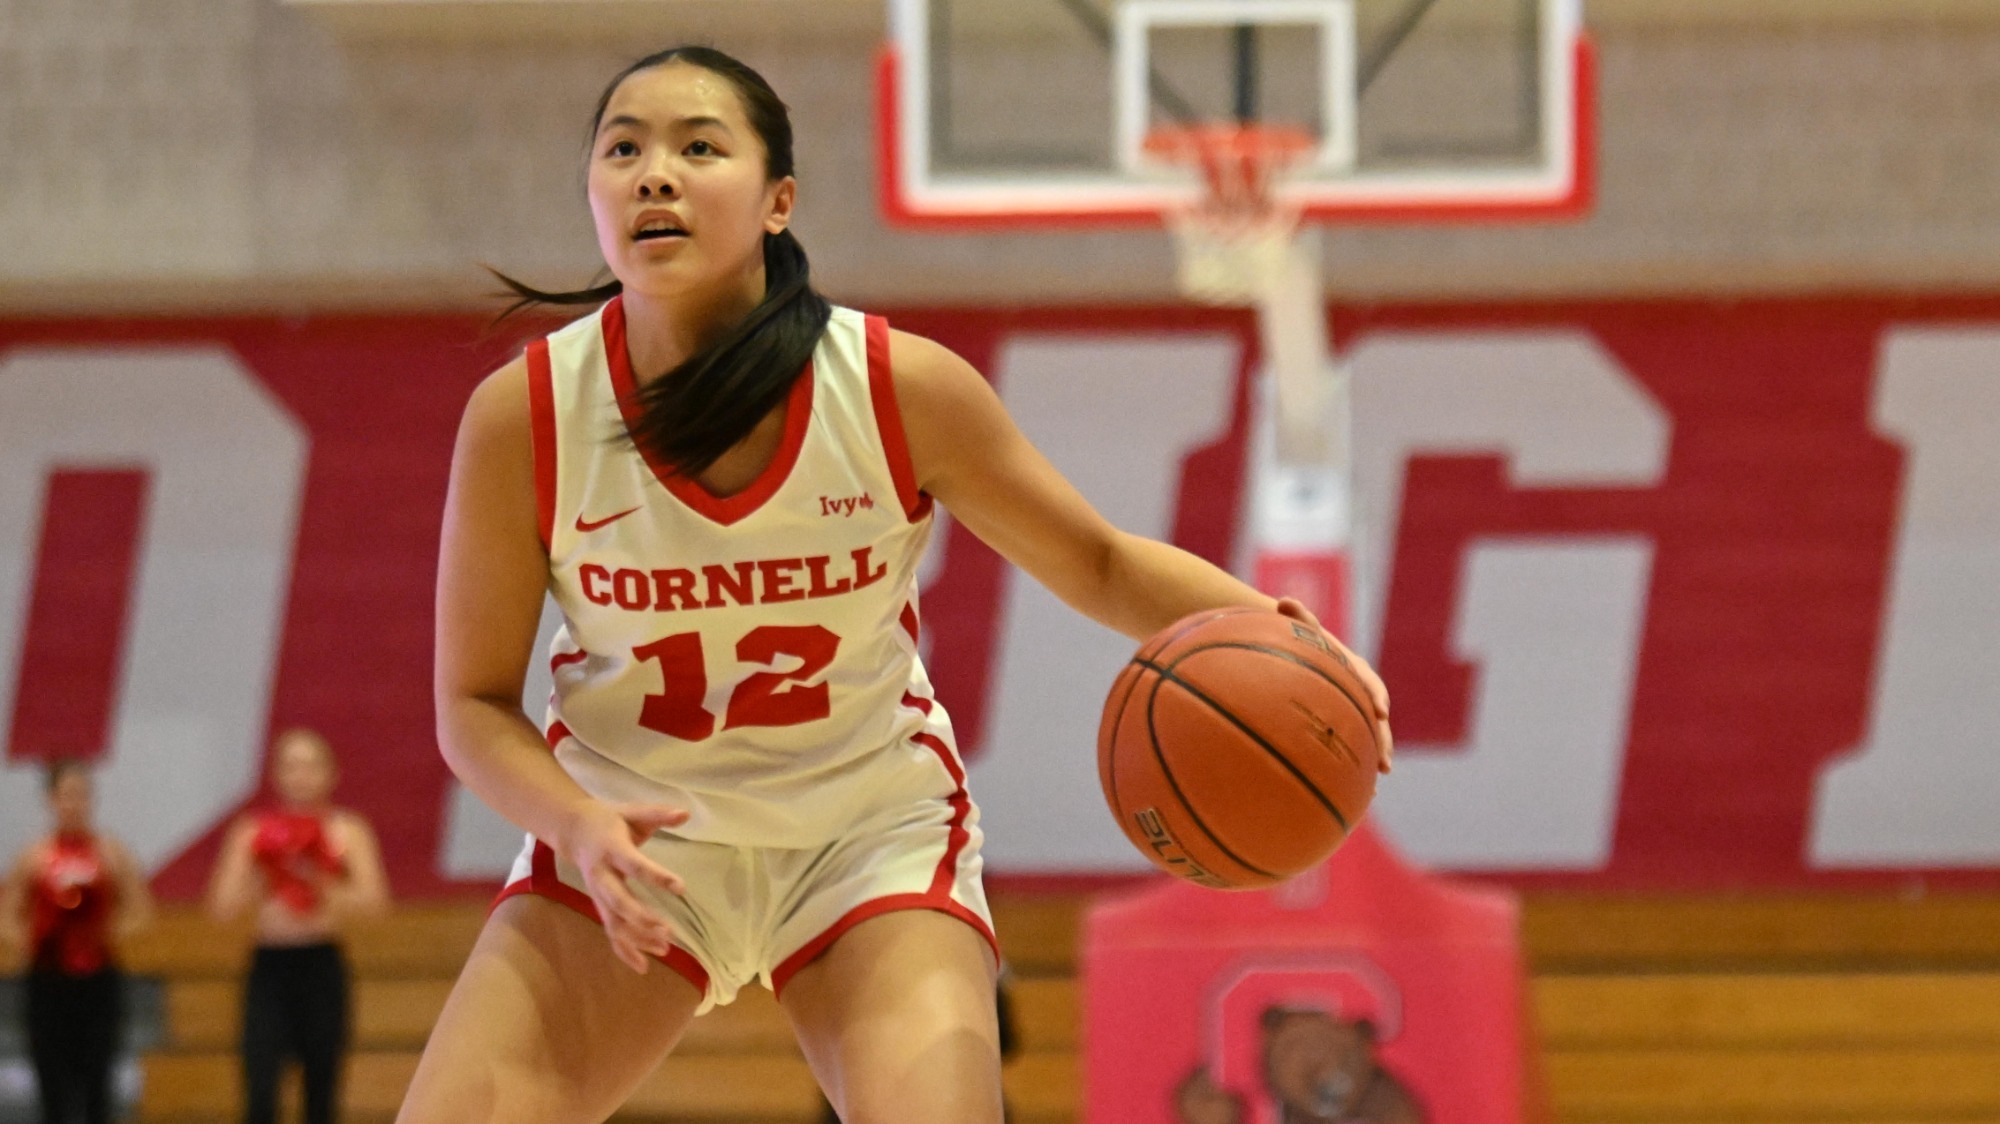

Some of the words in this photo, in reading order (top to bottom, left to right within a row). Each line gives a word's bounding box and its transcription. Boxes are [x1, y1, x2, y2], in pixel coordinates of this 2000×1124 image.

[819, 496, 857, 518] Ivy
[579, 546, 887, 612] CORNELL
[632, 624, 842, 742] 12
[1134, 807, 1228, 887] LITE
